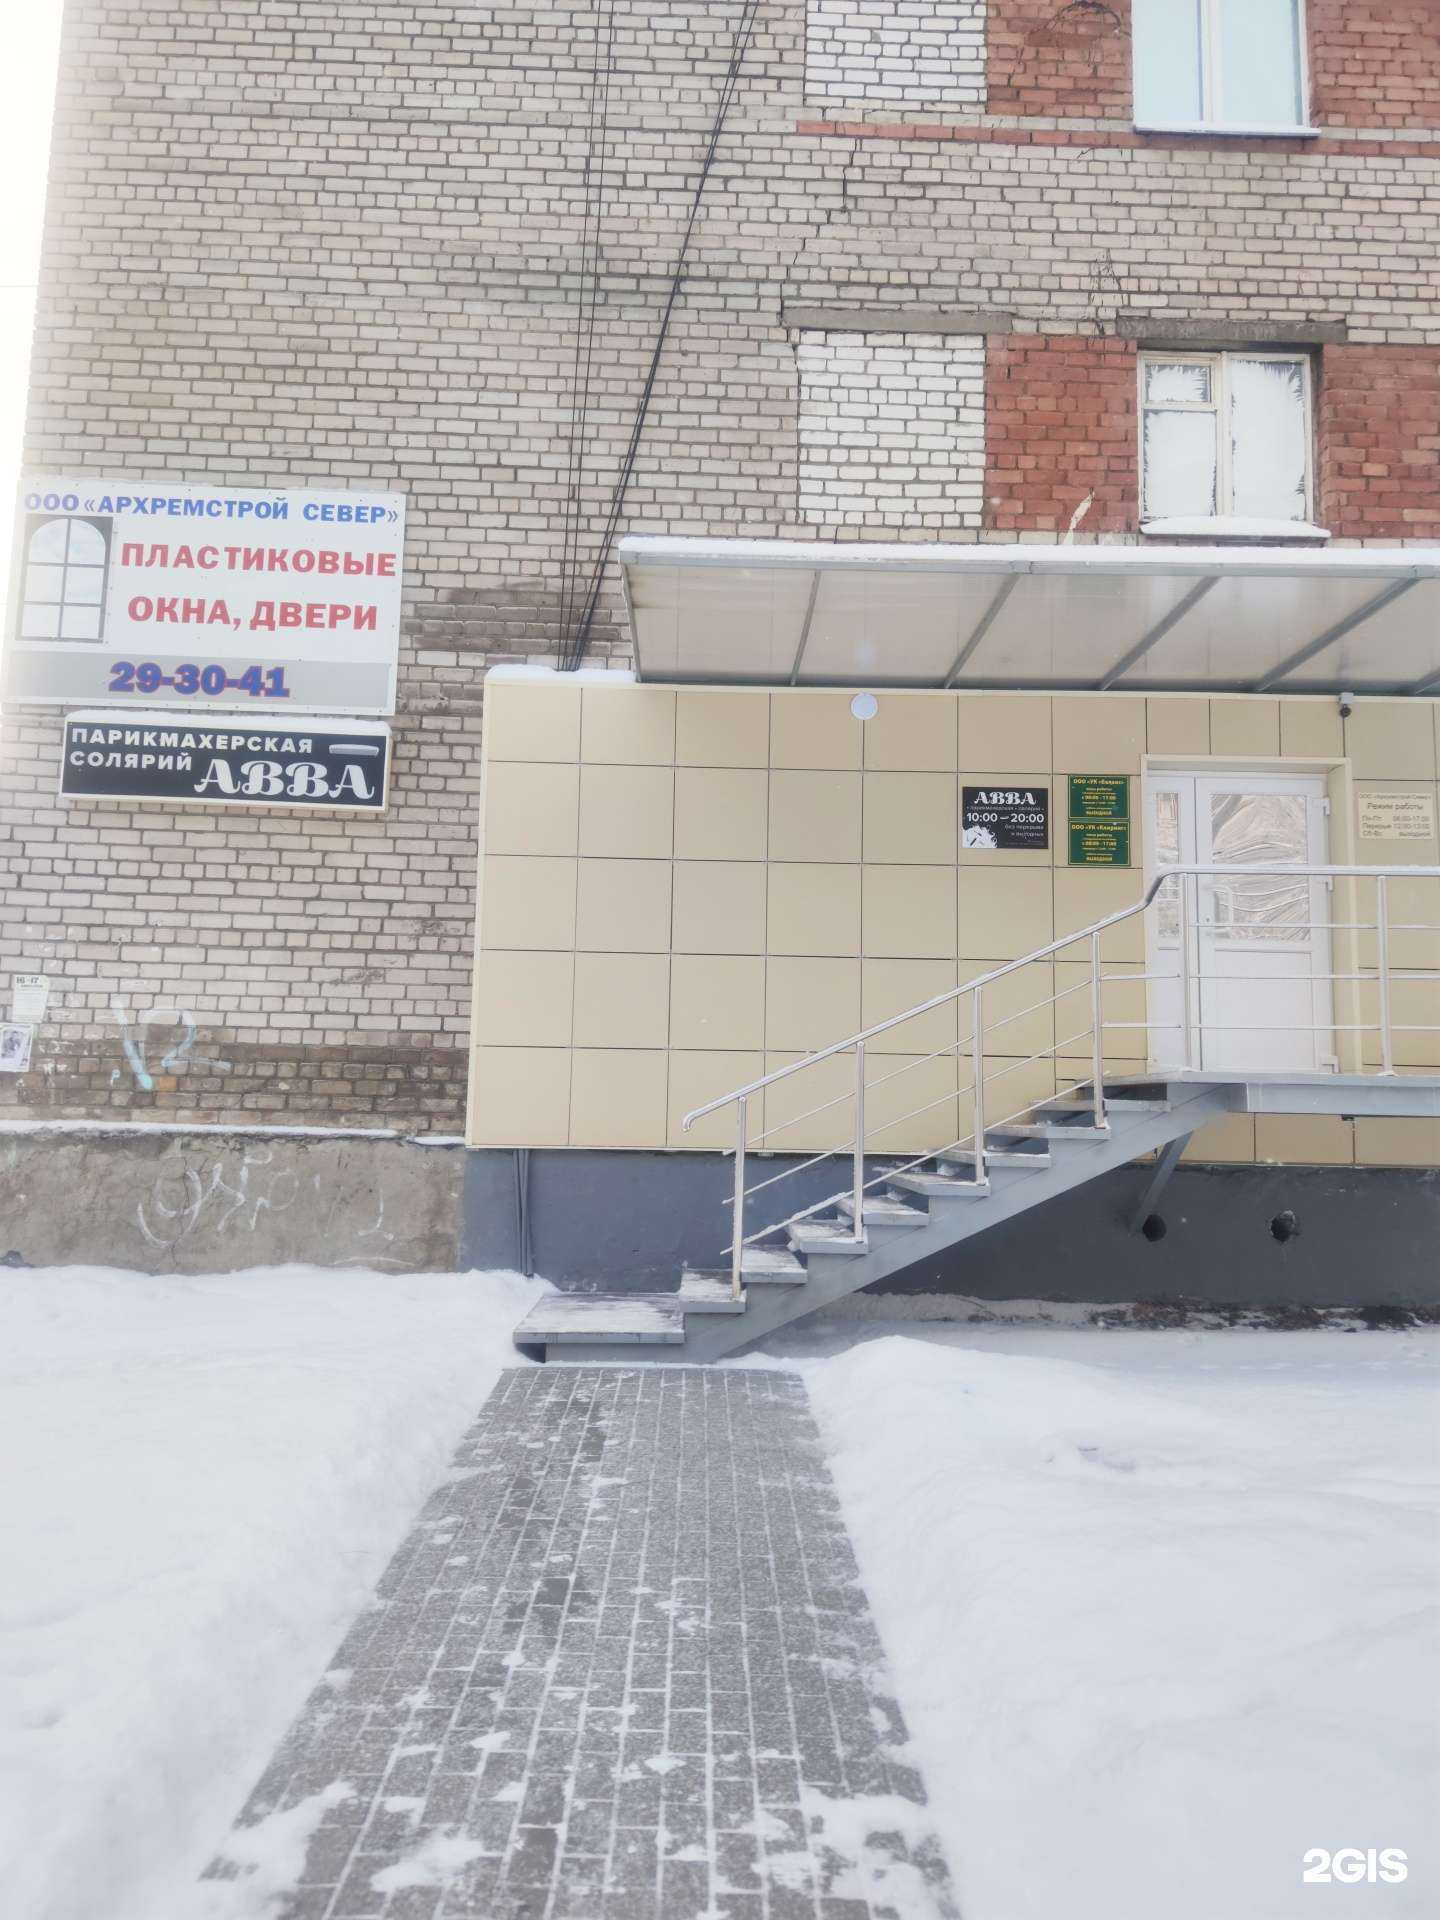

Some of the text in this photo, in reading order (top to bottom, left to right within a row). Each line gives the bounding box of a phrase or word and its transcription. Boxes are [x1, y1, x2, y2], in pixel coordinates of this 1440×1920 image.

[24, 493, 398, 523] ООО «АРХРЕМСТРОЙ СЕВЕР»
[121, 543, 397, 577] ПЛАСТИКОВЫЕ
[128, 596, 378, 631] ОКНА, ДВЕРИ
[108, 661, 290, 698] 29-30-41
[71, 727, 313, 754] ПАРИКМАХЕРСКАЯ
[70, 751, 193, 771] СОЛЯРИЙ
[966, 812, 998, 823] 10:00
[1010, 813, 1045, 823] 20:00
